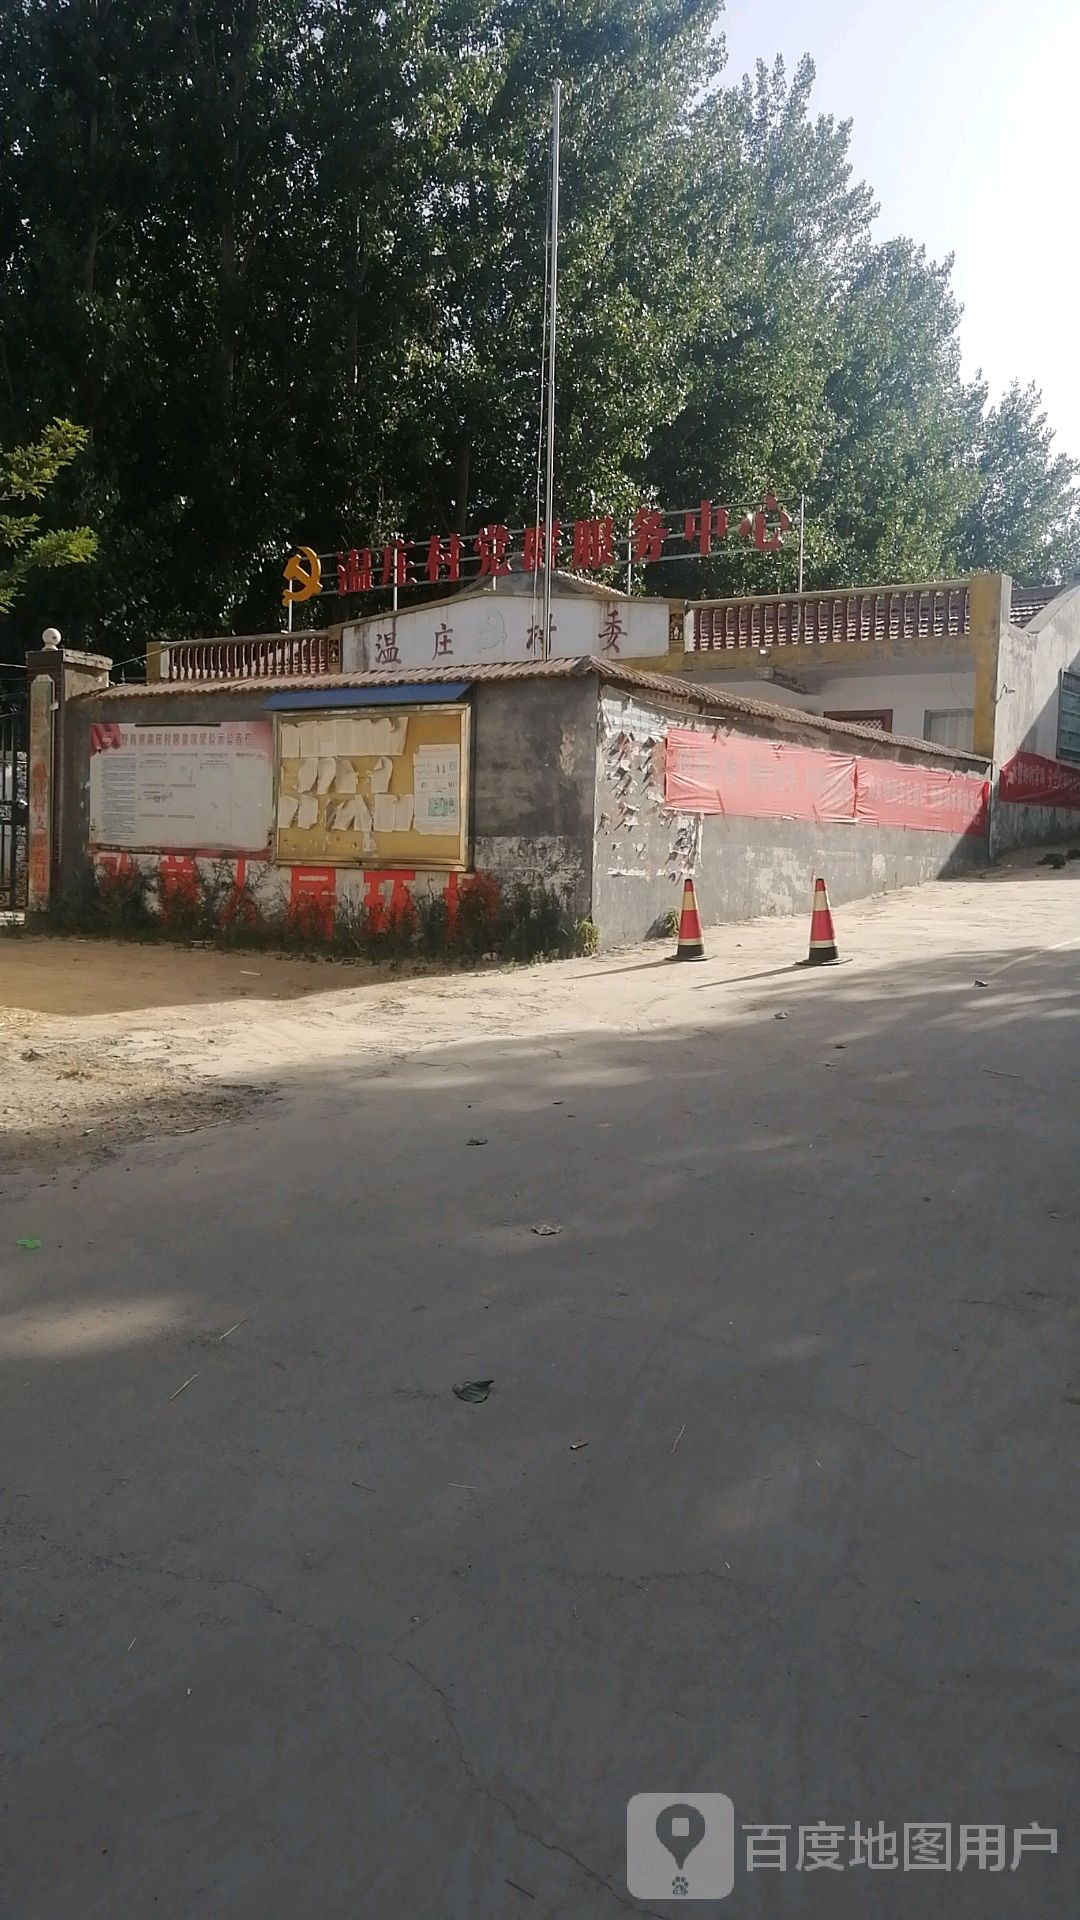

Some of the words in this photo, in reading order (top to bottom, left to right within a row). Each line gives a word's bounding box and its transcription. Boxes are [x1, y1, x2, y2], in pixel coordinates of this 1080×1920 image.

[337, 495, 791, 595] 温庄村党群服务中心
[375, 609, 628, 664] 温庄村委
